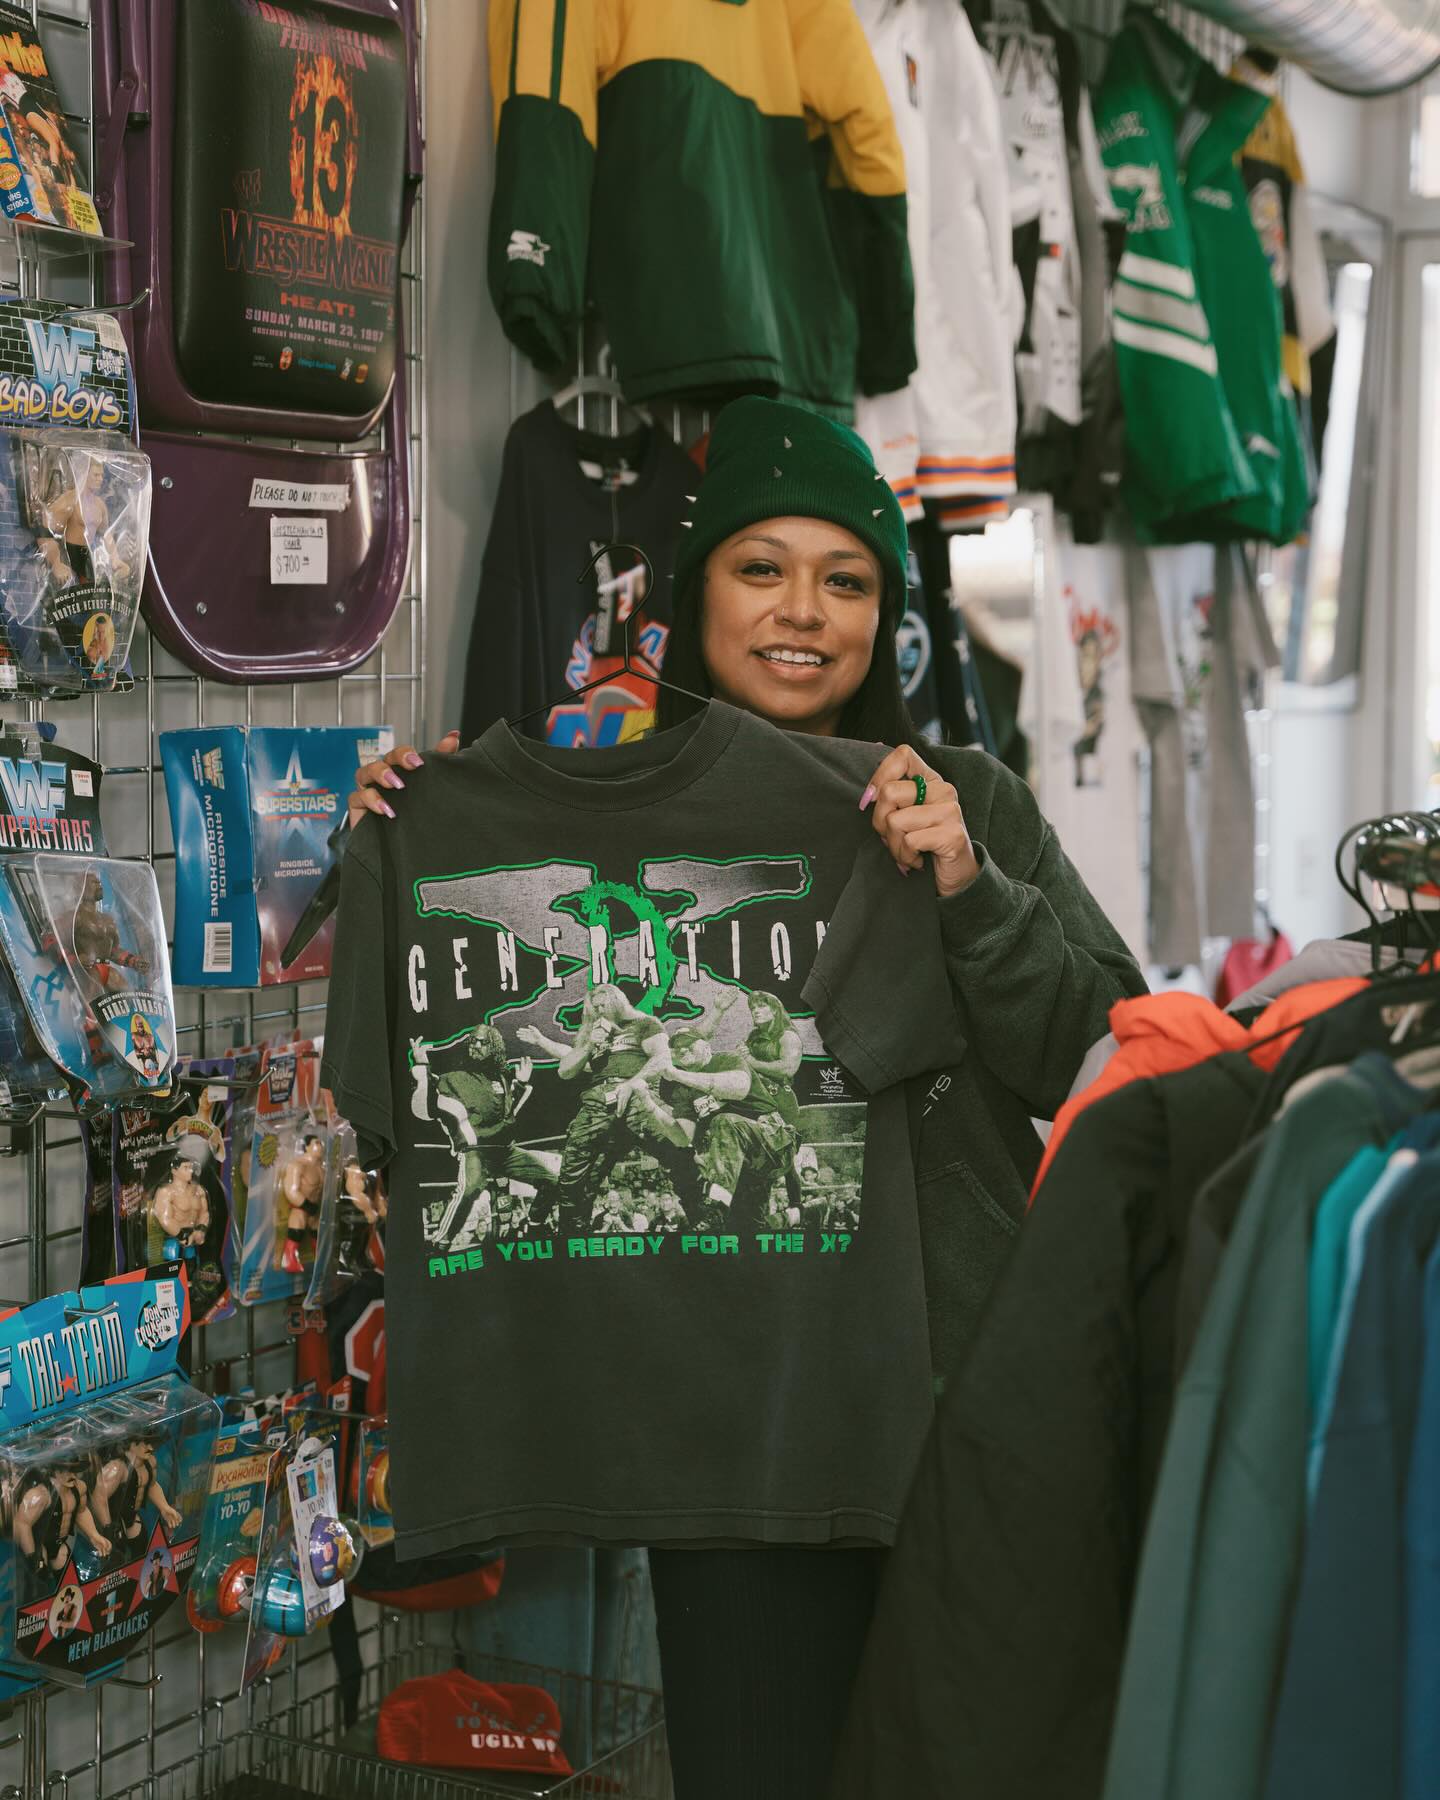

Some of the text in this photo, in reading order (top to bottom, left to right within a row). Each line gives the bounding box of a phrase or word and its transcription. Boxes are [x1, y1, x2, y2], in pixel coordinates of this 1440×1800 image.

[221, 208, 398, 290] WRESTLEMANI
[280, 291, 357, 318] HEAT!
[245, 308, 295, 328] SUNDAY,
[298, 316, 336, 334] MARCH
[361, 327, 385, 343] 1997
[0, 377, 121, 425] BAD BOYS
[253, 483, 286, 501] PLEASE
[288, 488, 300, 502] DO
[257, 793, 337, 815] SUPERSTARS
[0, 813, 94, 852] UPERSTARS
[204, 794, 218, 918] MICROPHONE
[215, 811, 227, 900] RINGSIDE
[279, 858, 315, 869] RINGSIDE
[274, 866, 322, 879] MICROPHONE
[429, 1233, 852, 1278] ARE YOU READY FOR THE X?
[17, 1332, 65, 1413] TAG
[61, 1311, 129, 1397] TEAM
[220, 1500, 250, 1520] YO-YO
[17, 1620, 46, 1640] BRADSHAW
[18, 1608, 48, 1627] BLACKJACK
[68, 1610, 149, 1664] NEW BLACKJACKS
[470, 1733, 526, 1750] UGLY
